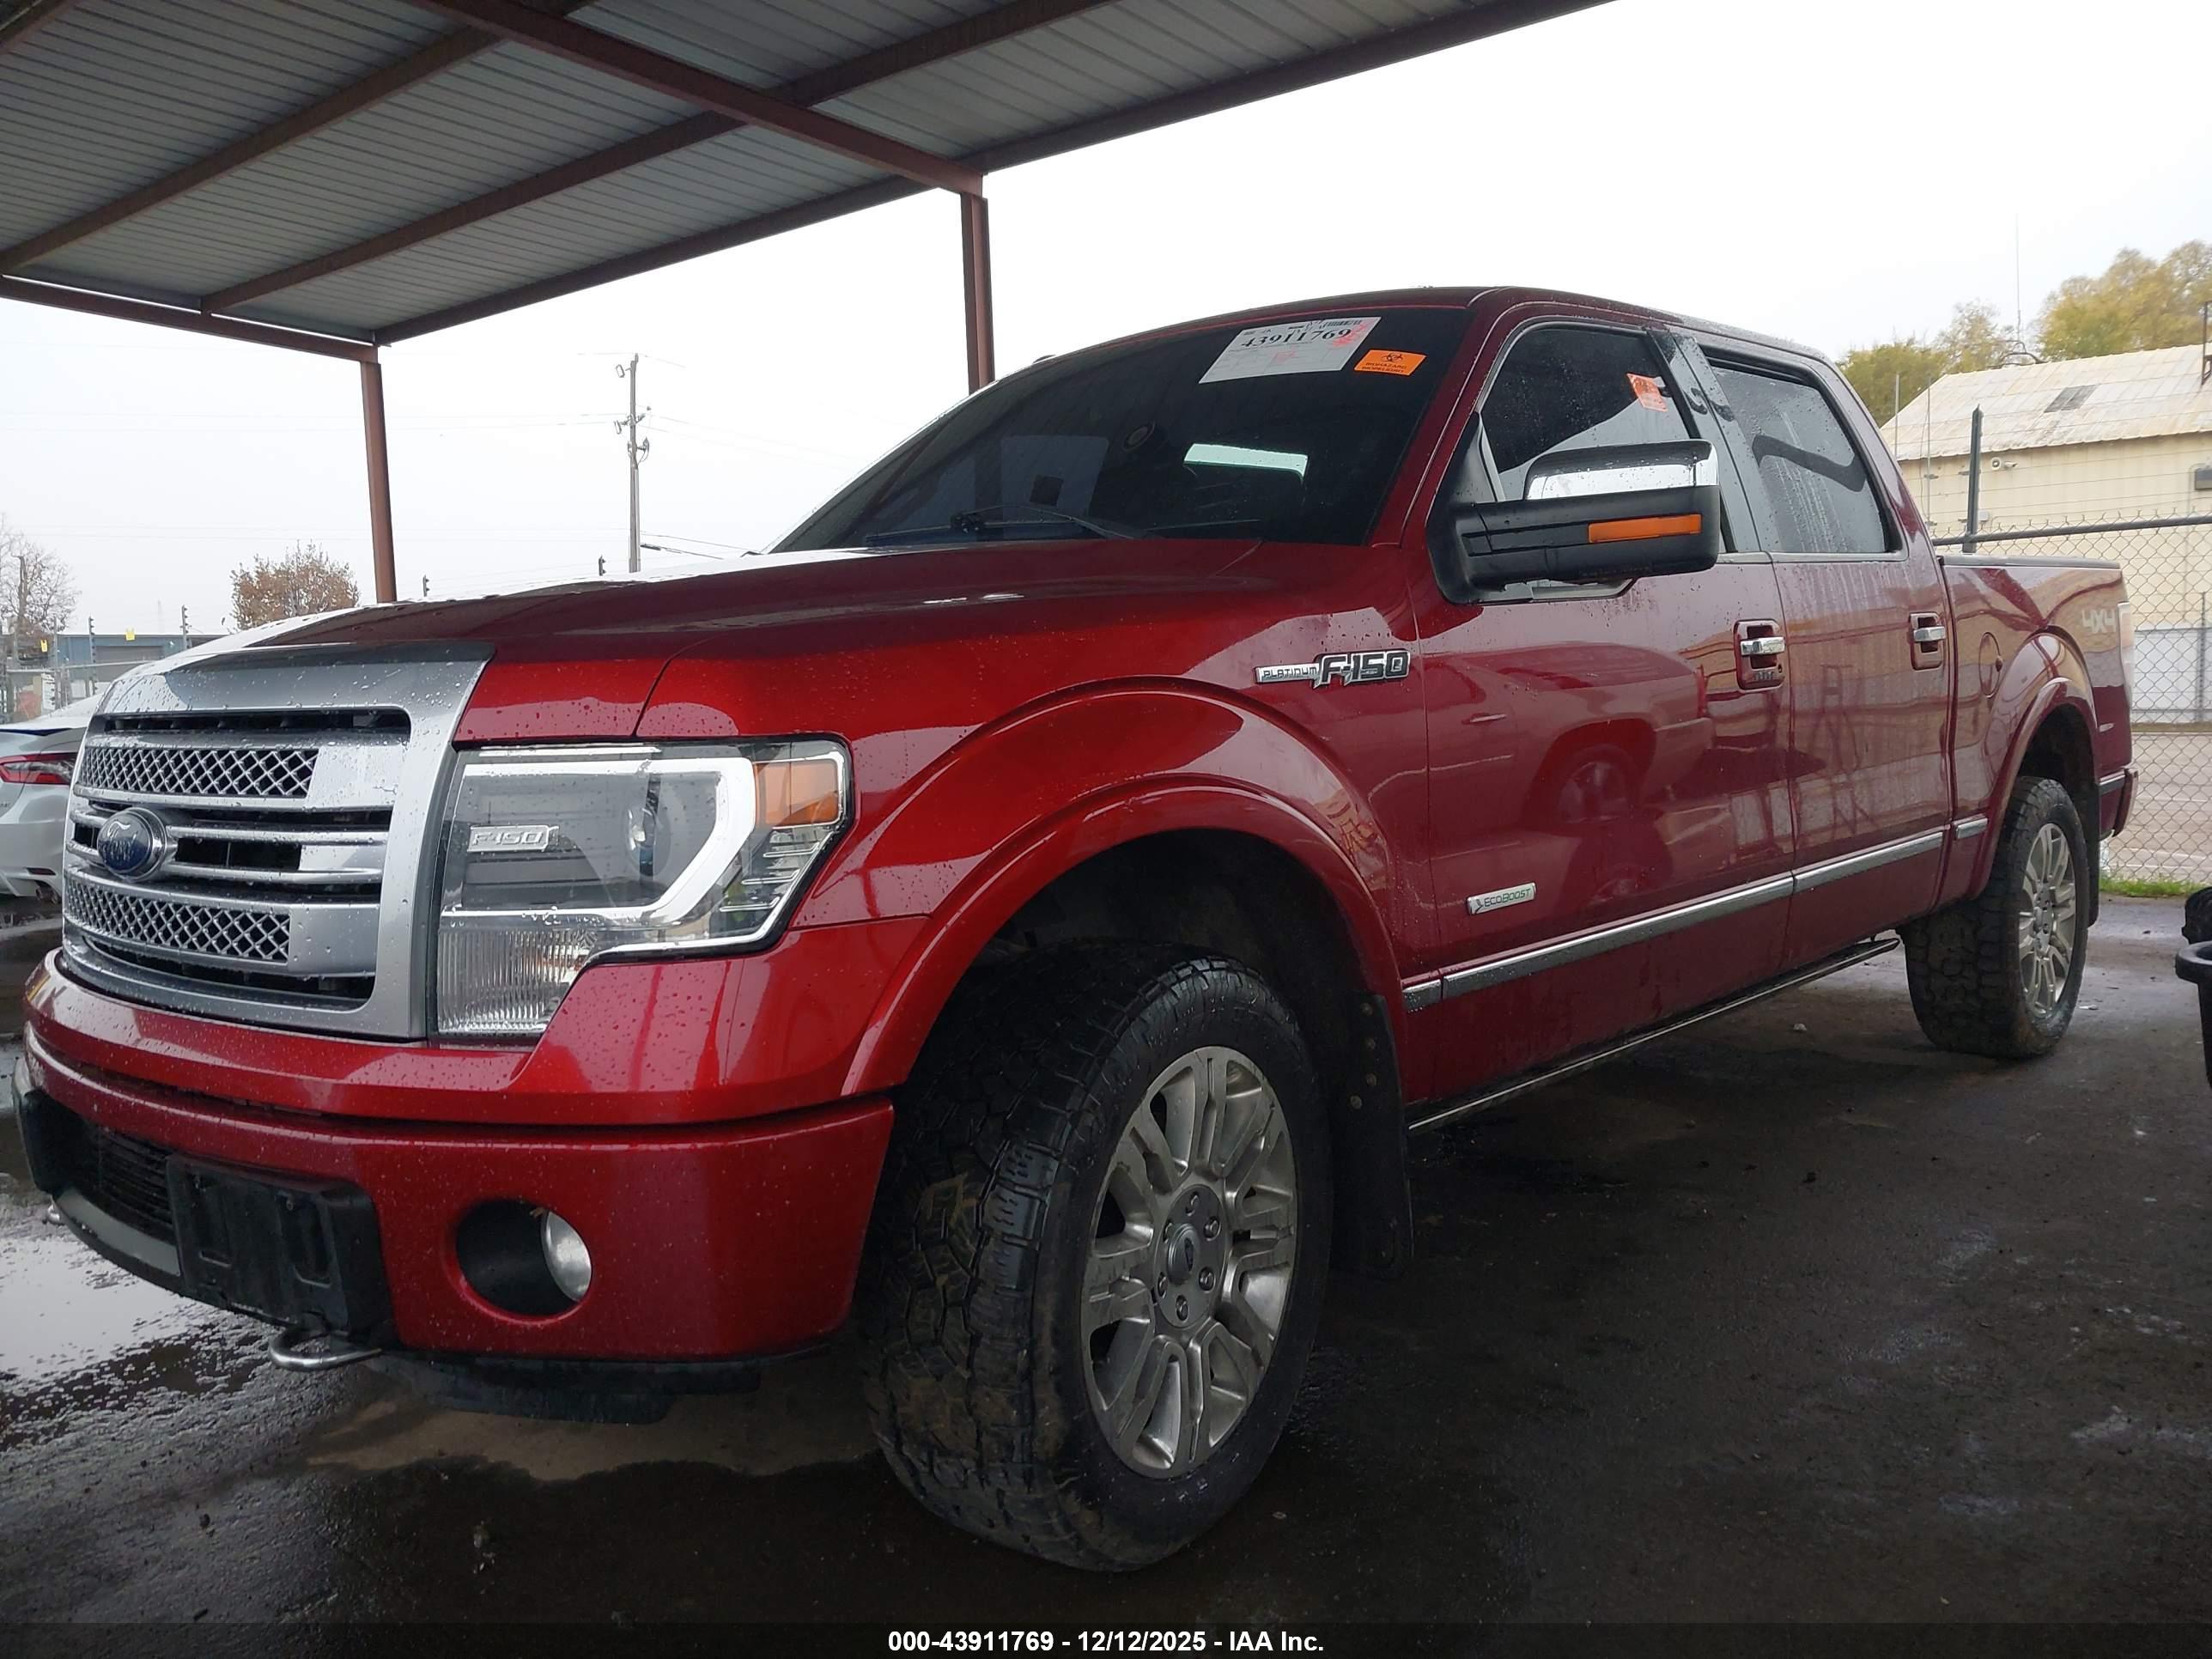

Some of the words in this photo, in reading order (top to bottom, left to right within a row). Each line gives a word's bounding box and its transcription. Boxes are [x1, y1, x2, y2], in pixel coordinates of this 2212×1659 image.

[1242, 328, 1352, 348] 43911769
[1263, 665, 1317, 678] PLATINUM
[1317, 651, 1410, 686] F-150
[103, 818, 139, 861] Ford
